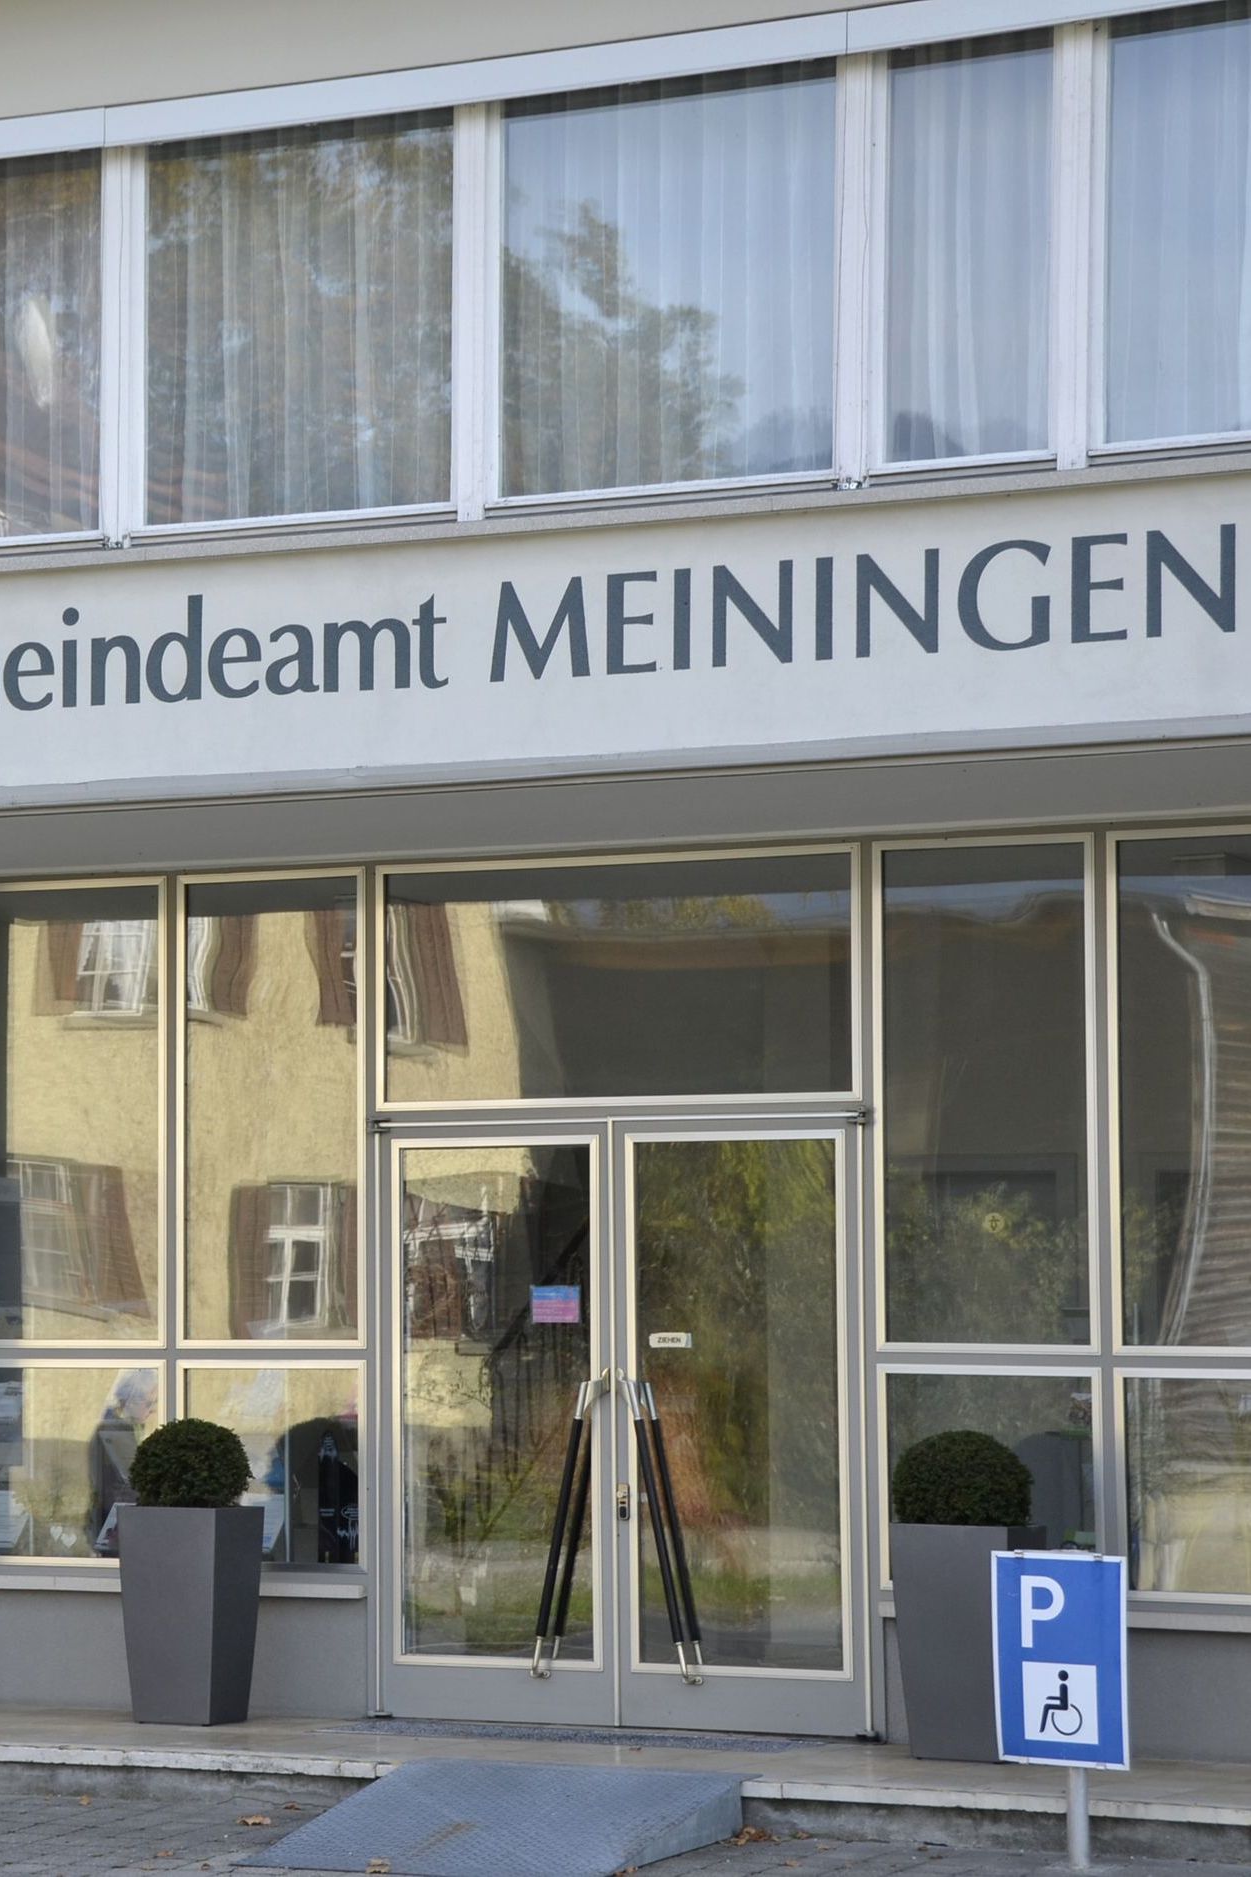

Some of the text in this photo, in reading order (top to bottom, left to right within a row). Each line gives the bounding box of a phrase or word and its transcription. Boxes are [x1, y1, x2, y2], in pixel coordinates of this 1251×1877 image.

[489, 523, 1236, 682] MEININGEN
[657, 1336, 682, 1344] ZIEHEN
[1020, 1575, 1065, 1648] P
